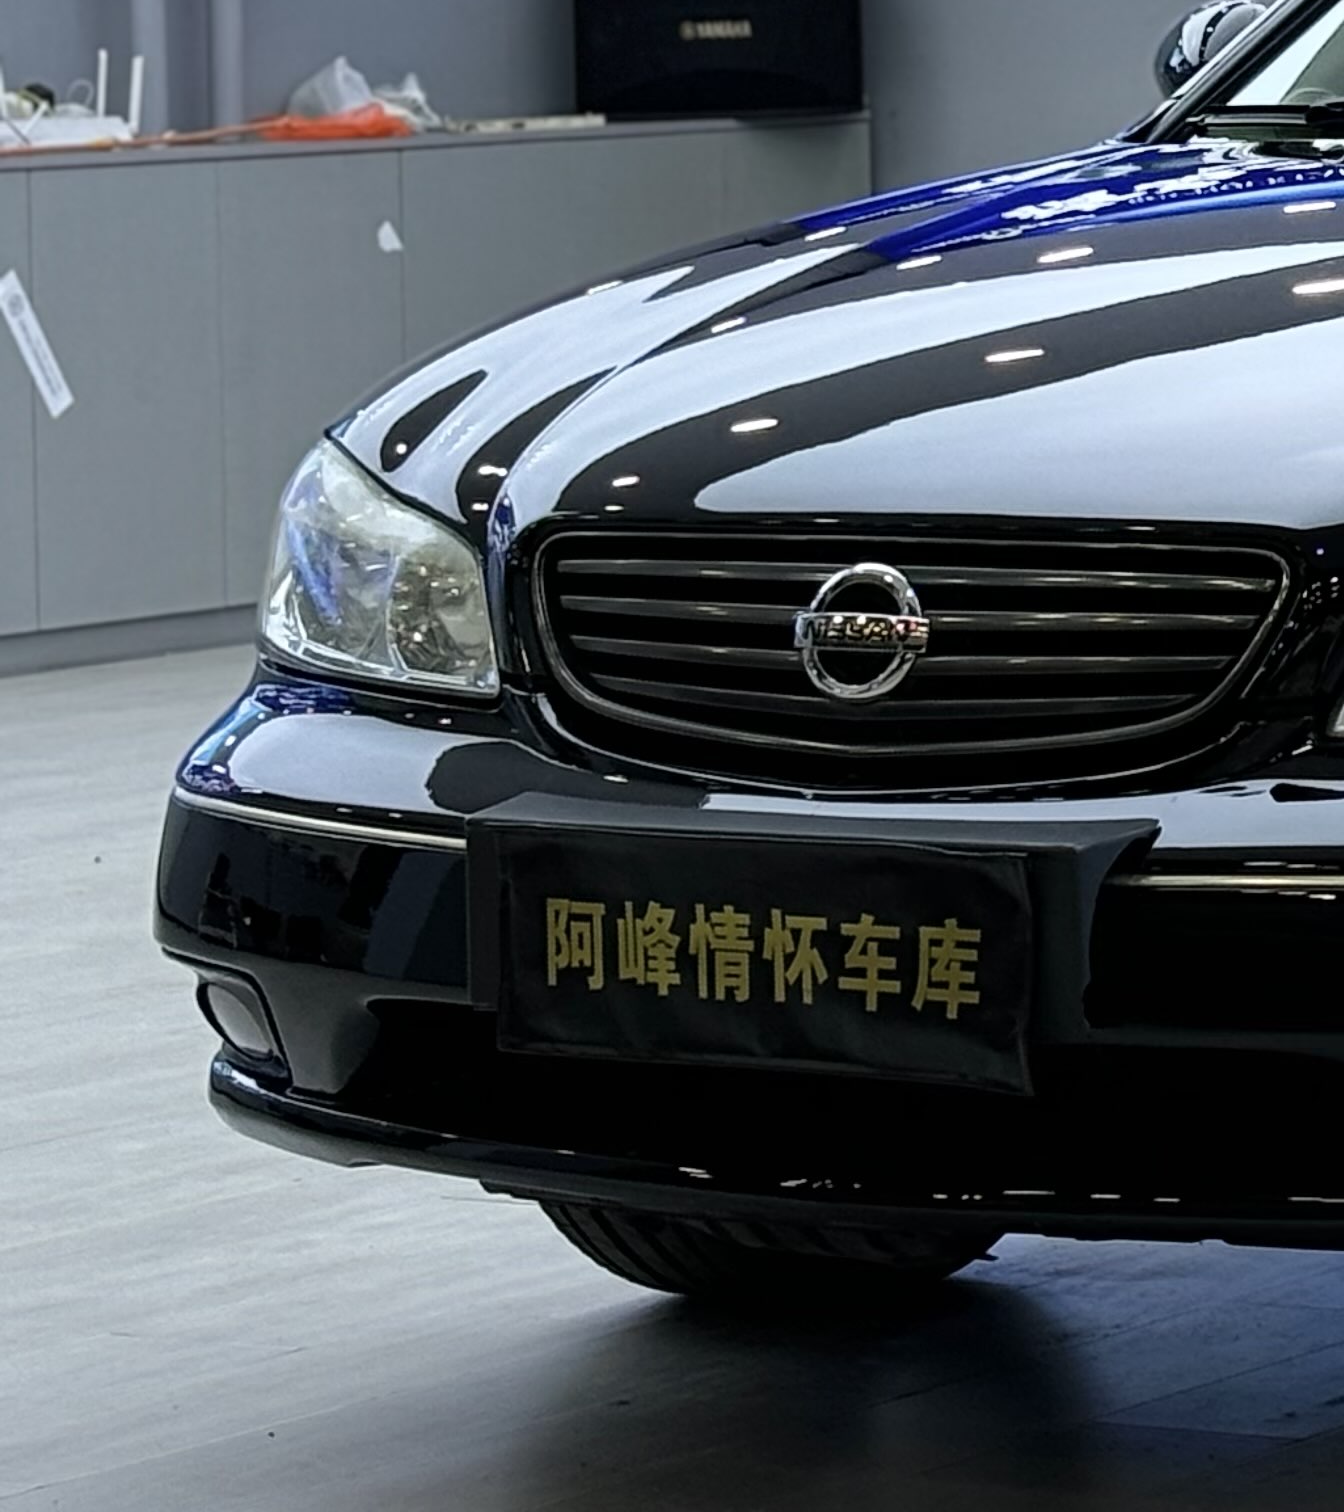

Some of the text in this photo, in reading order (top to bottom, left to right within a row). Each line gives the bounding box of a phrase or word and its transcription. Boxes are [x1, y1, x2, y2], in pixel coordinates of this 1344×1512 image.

[546, 898, 981, 1020] 阿峰情怀车库
